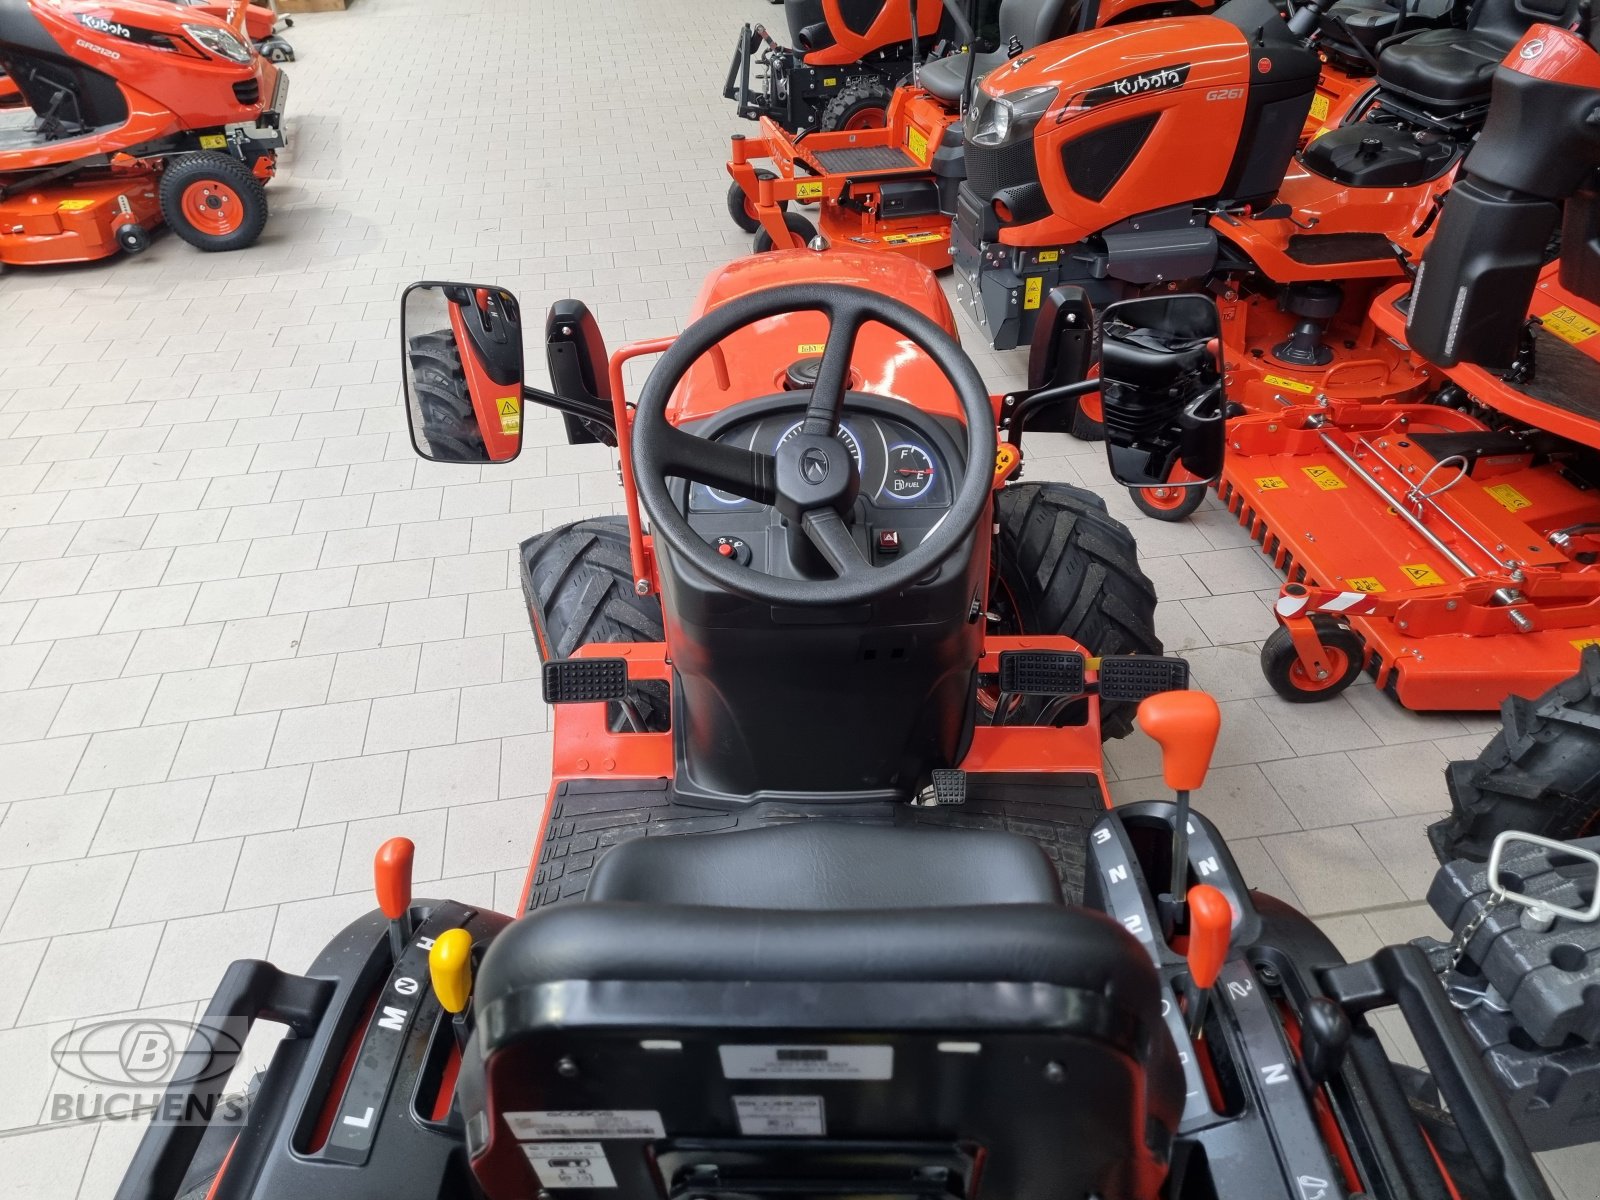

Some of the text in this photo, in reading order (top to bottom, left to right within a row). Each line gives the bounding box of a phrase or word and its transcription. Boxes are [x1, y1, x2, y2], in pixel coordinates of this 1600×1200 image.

[82, 14, 130, 38] Kubota
[76, 39, 120, 60] GR2120
[1114, 69, 1179, 95] Kubota
[1206, 88, 1244, 101] G261
[901, 449, 909, 459] F
[916, 470, 925, 480] E
[1108, 864, 1128, 884] N
[1198, 856, 1219, 876] N
[377, 1005, 408, 1032] M
[343, 1106, 375, 1128] L
